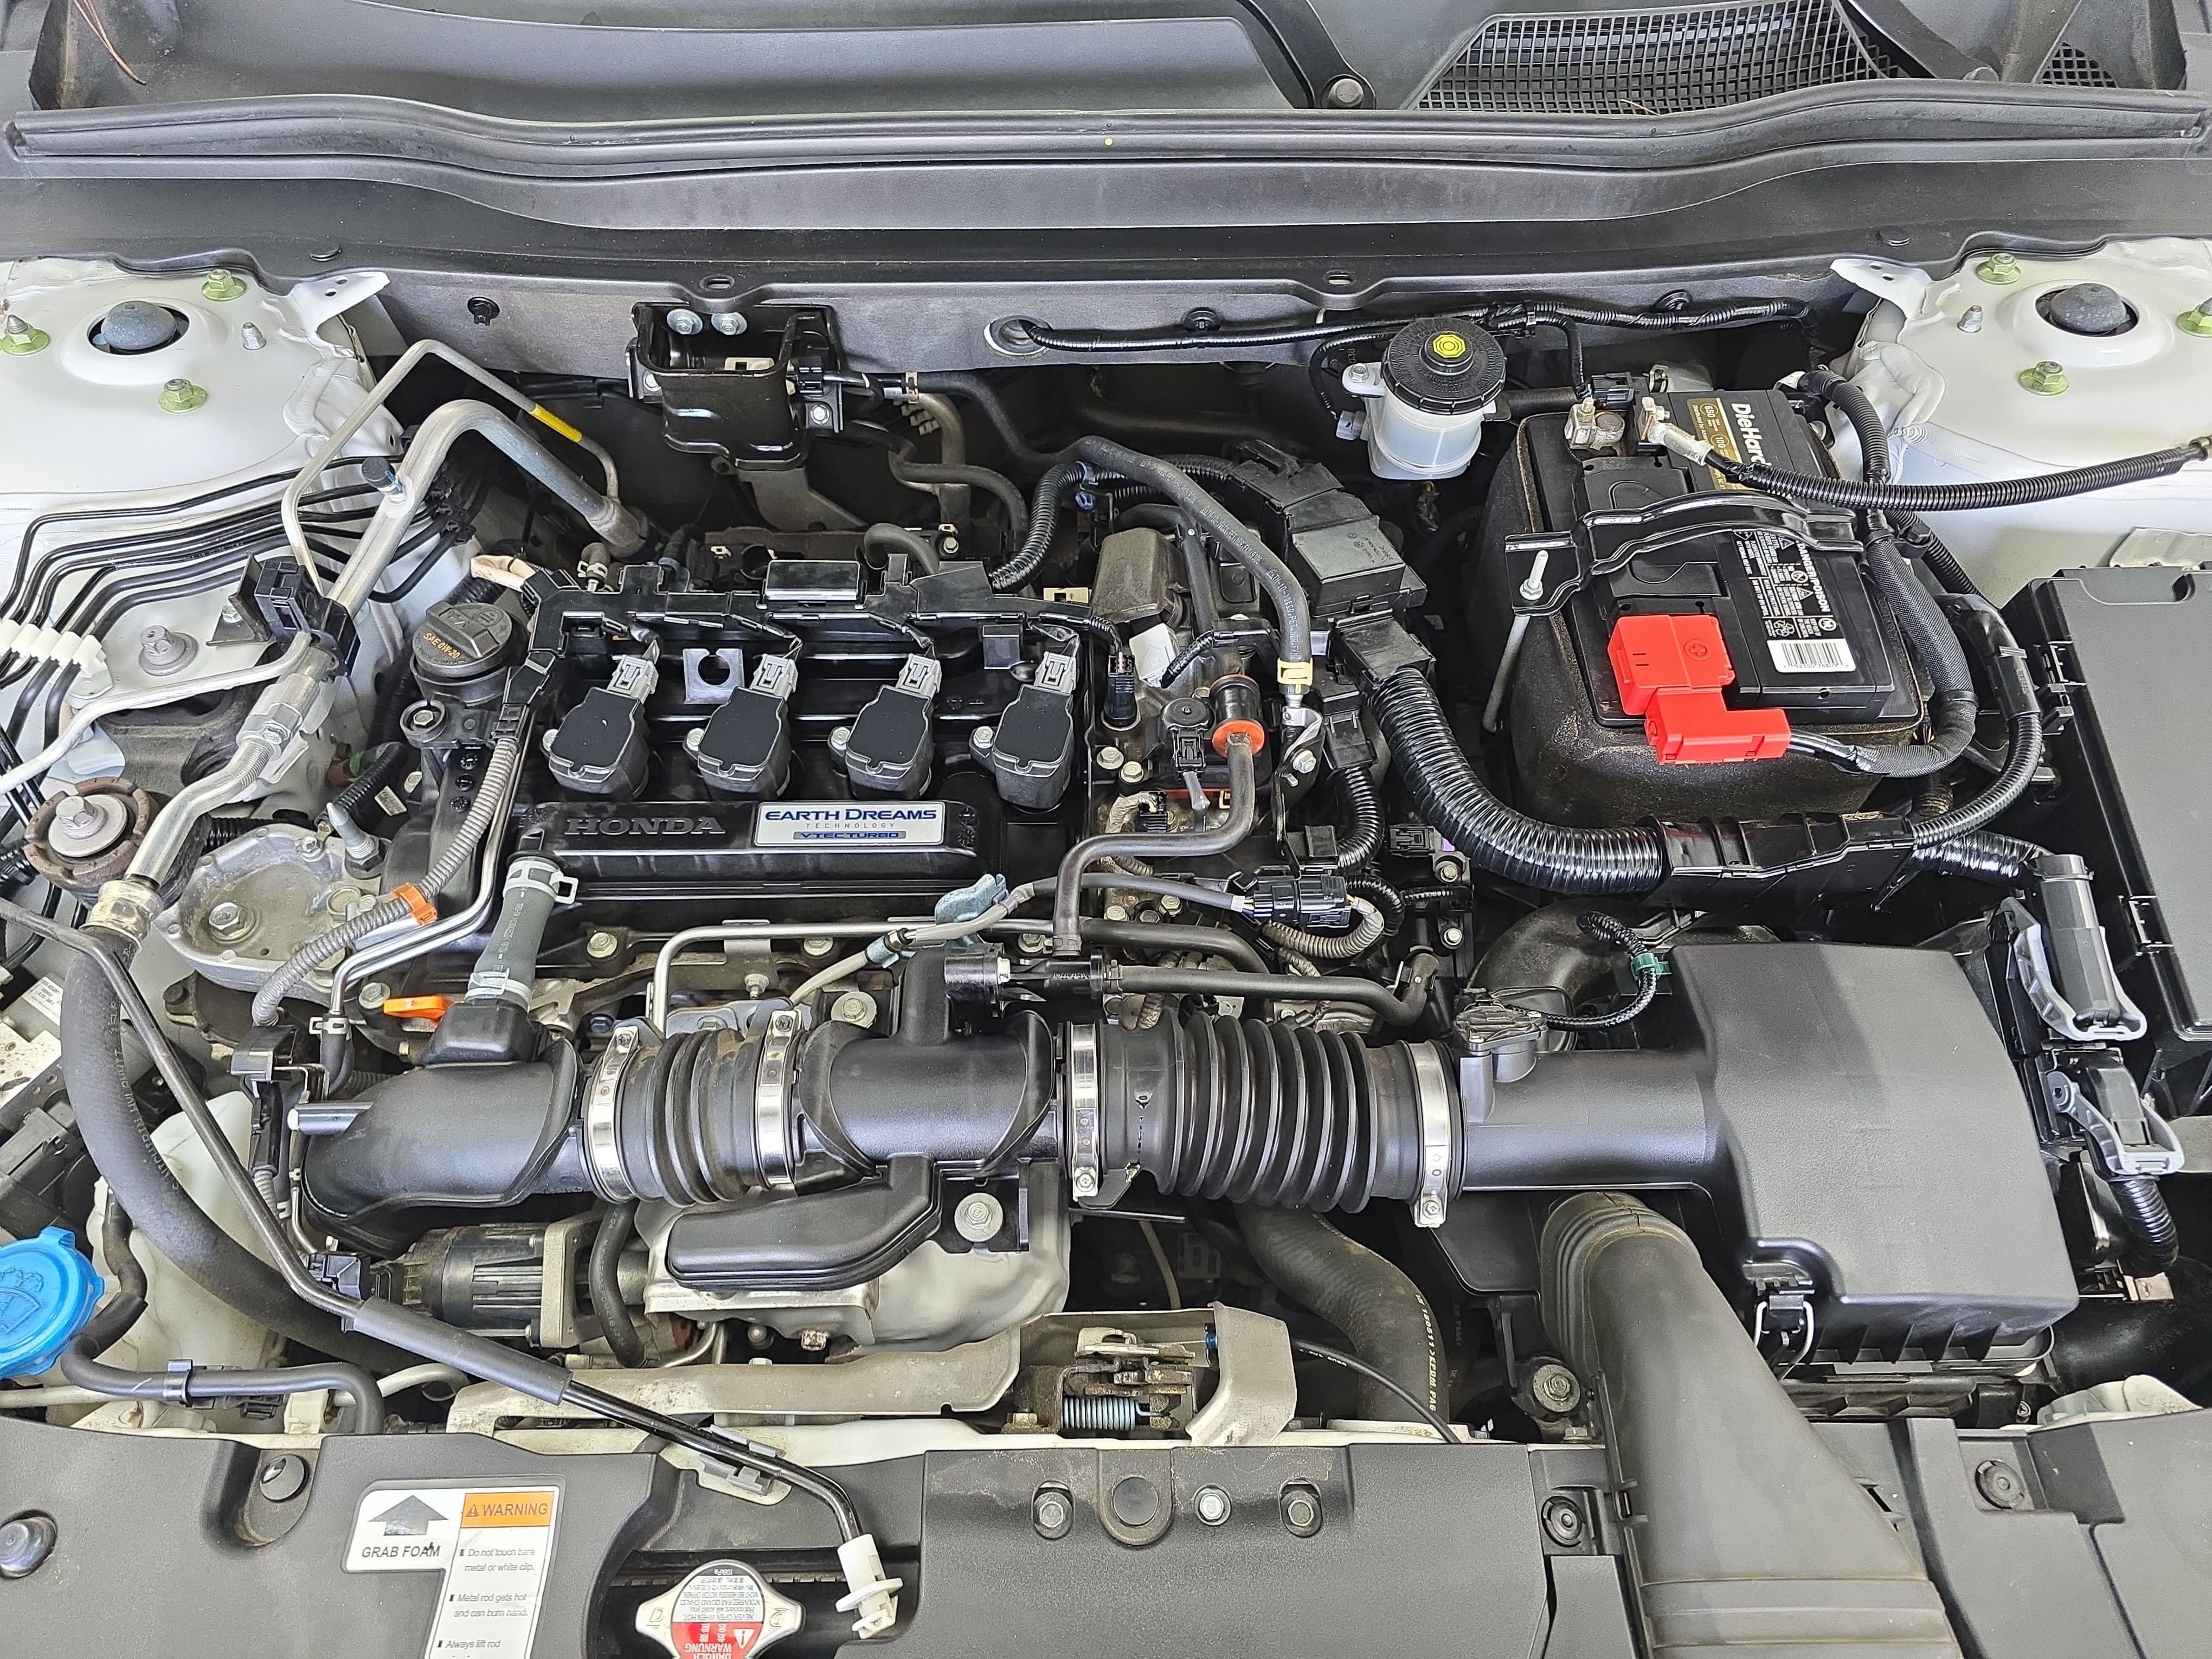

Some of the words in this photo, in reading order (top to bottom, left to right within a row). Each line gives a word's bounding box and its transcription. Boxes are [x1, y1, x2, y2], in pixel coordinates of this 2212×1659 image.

[1692, 406, 1703, 423] Distributed
[1704, 406, 1715, 417] 650
[1731, 403, 1772, 467] DieHard
[1715, 438, 1726, 447] 100
[1798, 543, 1831, 612] DANGER/POISON
[423, 633, 441, 646] SAE
[438, 641, 461, 659] 0W-20
[765, 811, 841, 821] EARTH
[845, 808, 937, 821] DREAMS
[564, 816, 726, 835] HONDA
[483, 1503, 548, 1516] WARNING
[362, 1546, 398, 1557] GRAB
[402, 1546, 440, 1557] FOAM
[519, 1563, 535, 1572] clip.
[495, 1594, 512, 1603] gets
[446, 1640, 474, 1649] Always
[684, 1643, 732, 1652] WARNUNG
